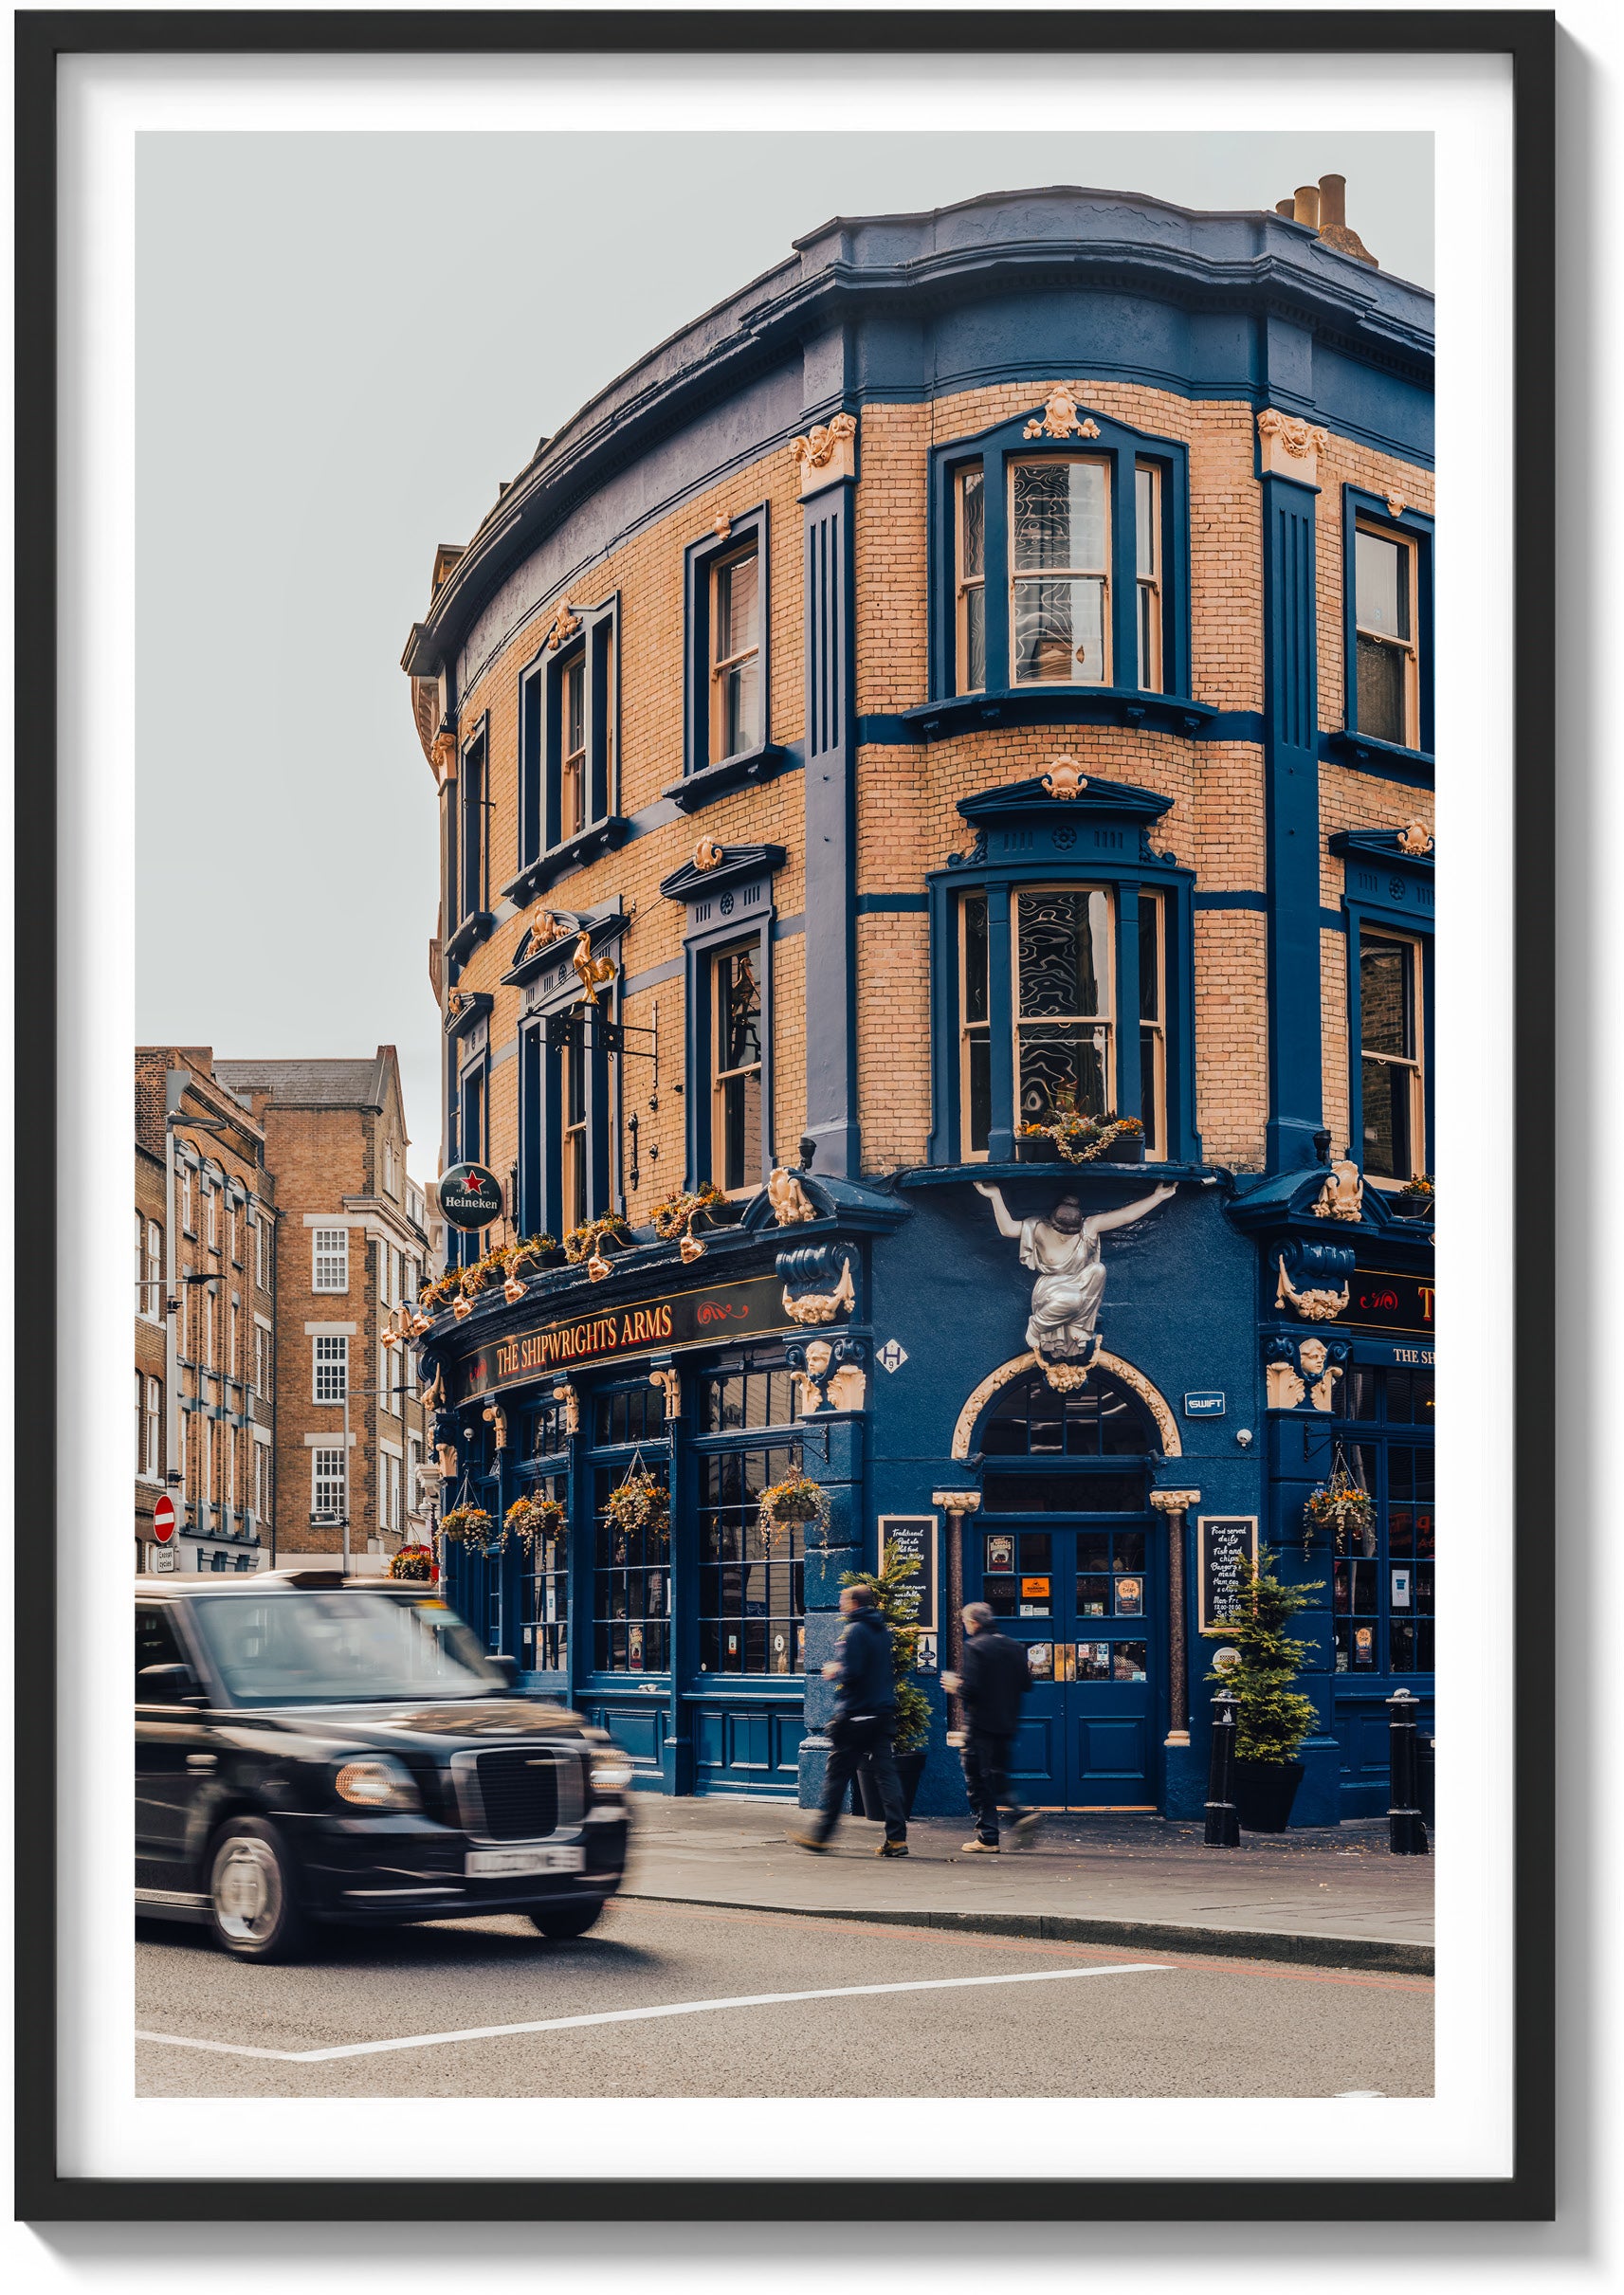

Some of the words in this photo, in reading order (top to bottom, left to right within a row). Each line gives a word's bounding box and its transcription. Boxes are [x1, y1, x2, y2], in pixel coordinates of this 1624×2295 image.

[446, 1196, 498, 1210] Heineken
[497, 1343, 520, 1375] THE
[521, 1317, 616, 1367] SHIPWRIGHTS
[621, 1304, 672, 1344] ARMS
[884, 1346, 901, 1365] H
[1394, 1348, 1419, 1363] THE
[888, 1361, 894, 1370] 9
[1189, 1399, 1222, 1409] SWIFT
[1211, 1525, 1226, 1536] Food
[1227, 1526, 1247, 1535] served
[1218, 1535, 1239, 1546] daily
[1213, 1545, 1228, 1556] Fish
[1229, 1546, 1242, 1555] and
[1219, 1555, 1239, 1564] chips
